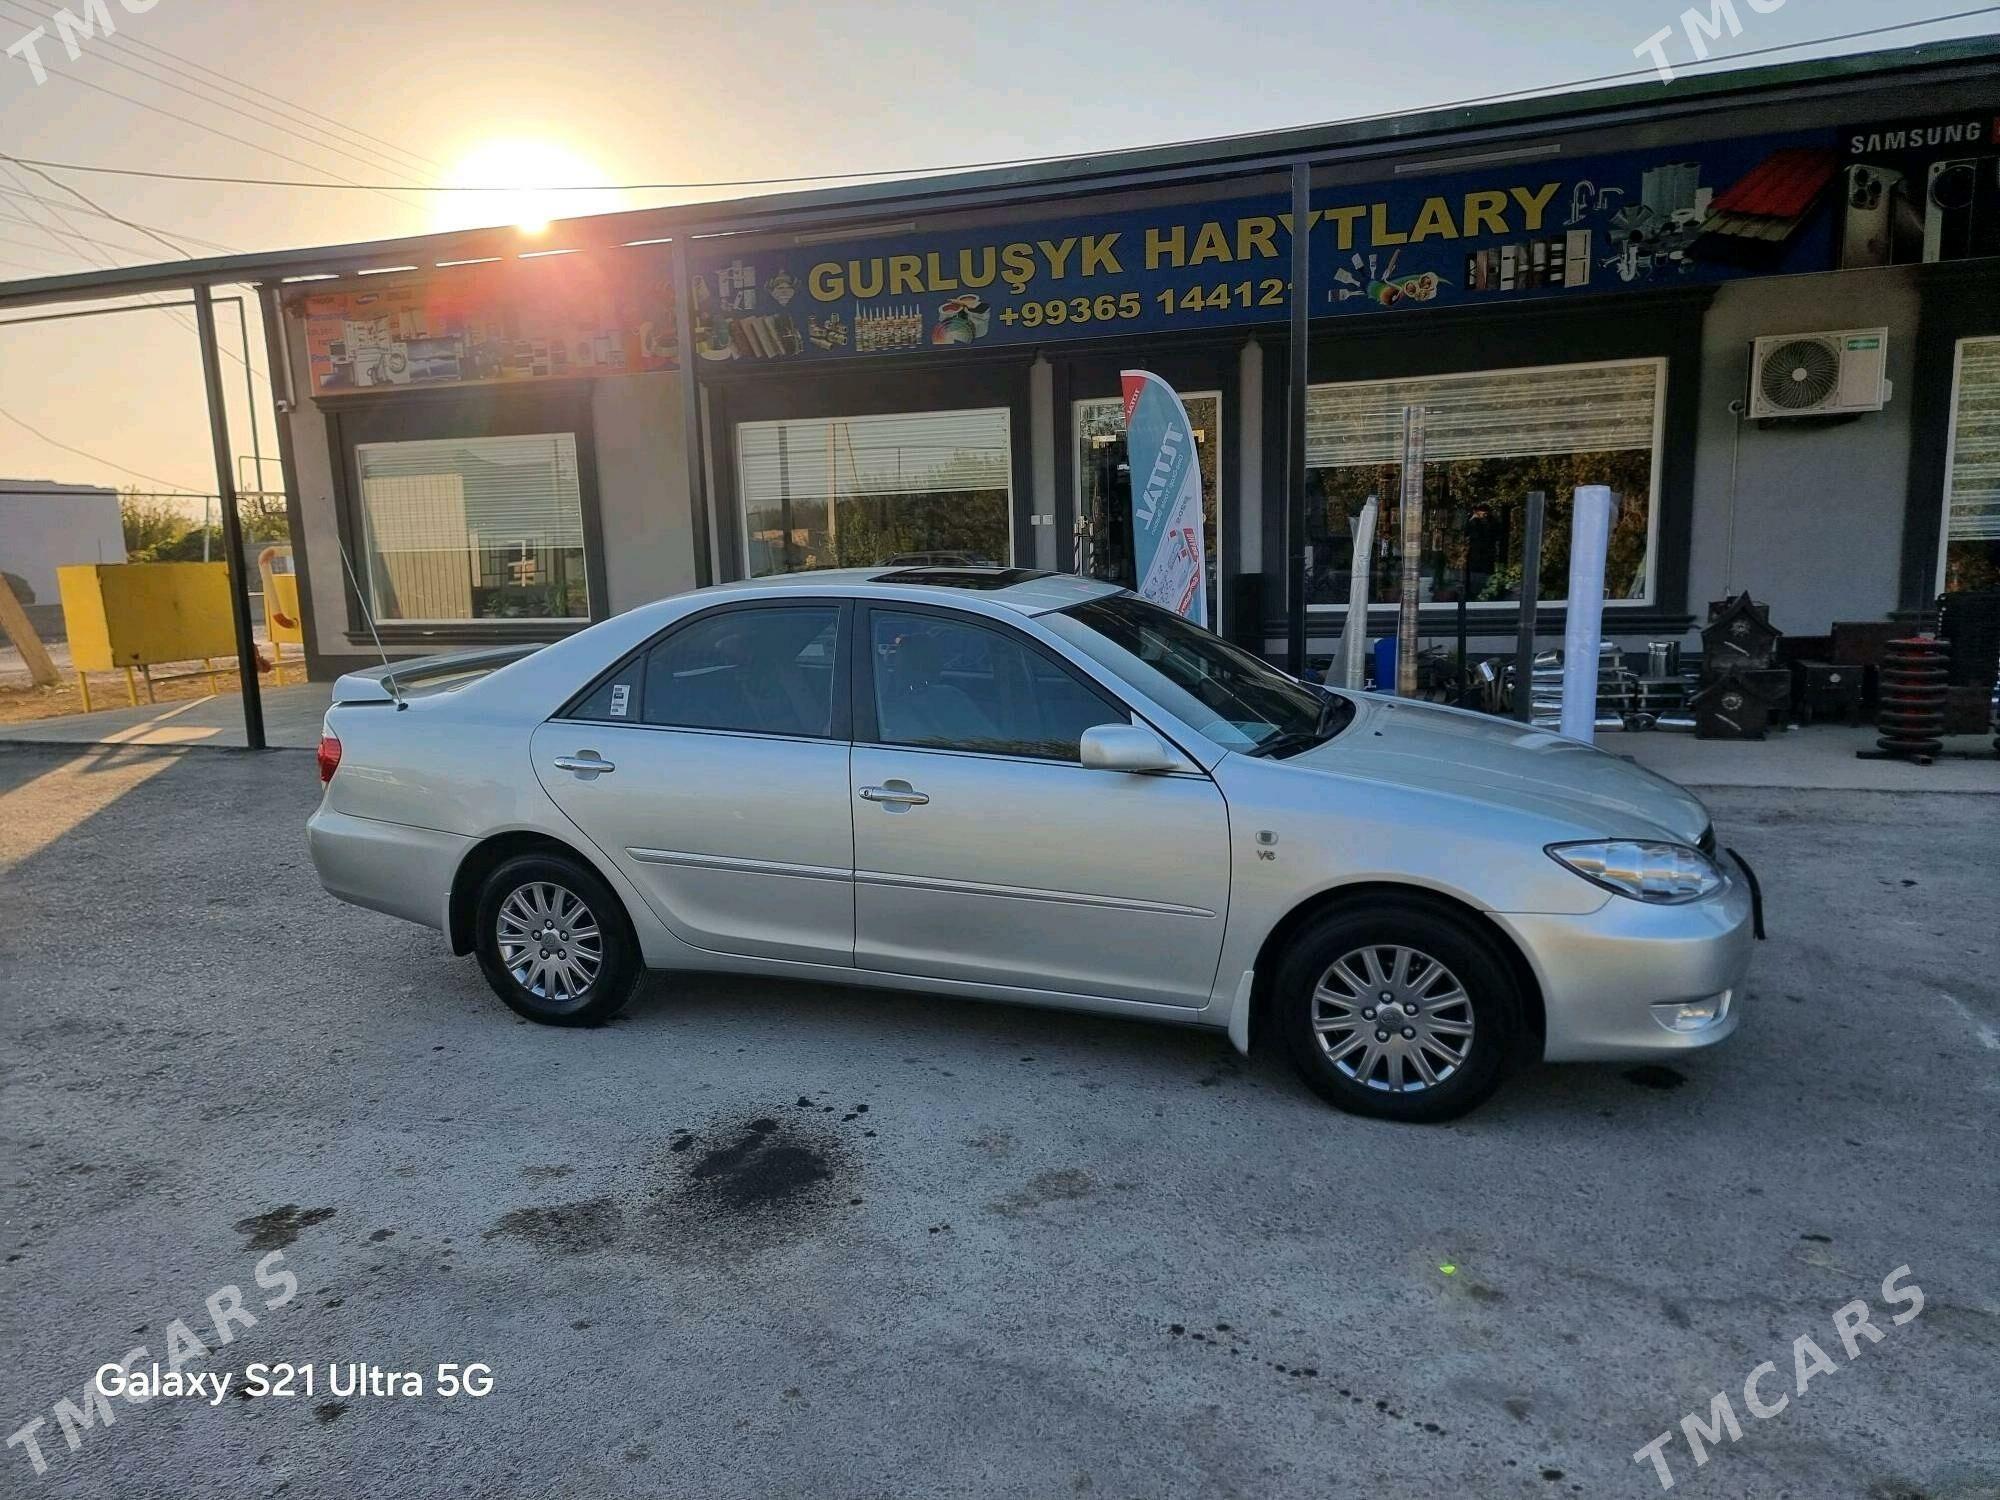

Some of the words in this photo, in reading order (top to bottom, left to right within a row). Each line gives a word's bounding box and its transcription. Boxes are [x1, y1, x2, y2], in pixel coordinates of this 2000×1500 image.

[1850, 122, 1982, 154] SAMSUNG
[807, 232, 1124, 295] GURLUŞYK
[998, 291, 1142, 329] +99365
[1156, 277, 1295, 316] 14412
